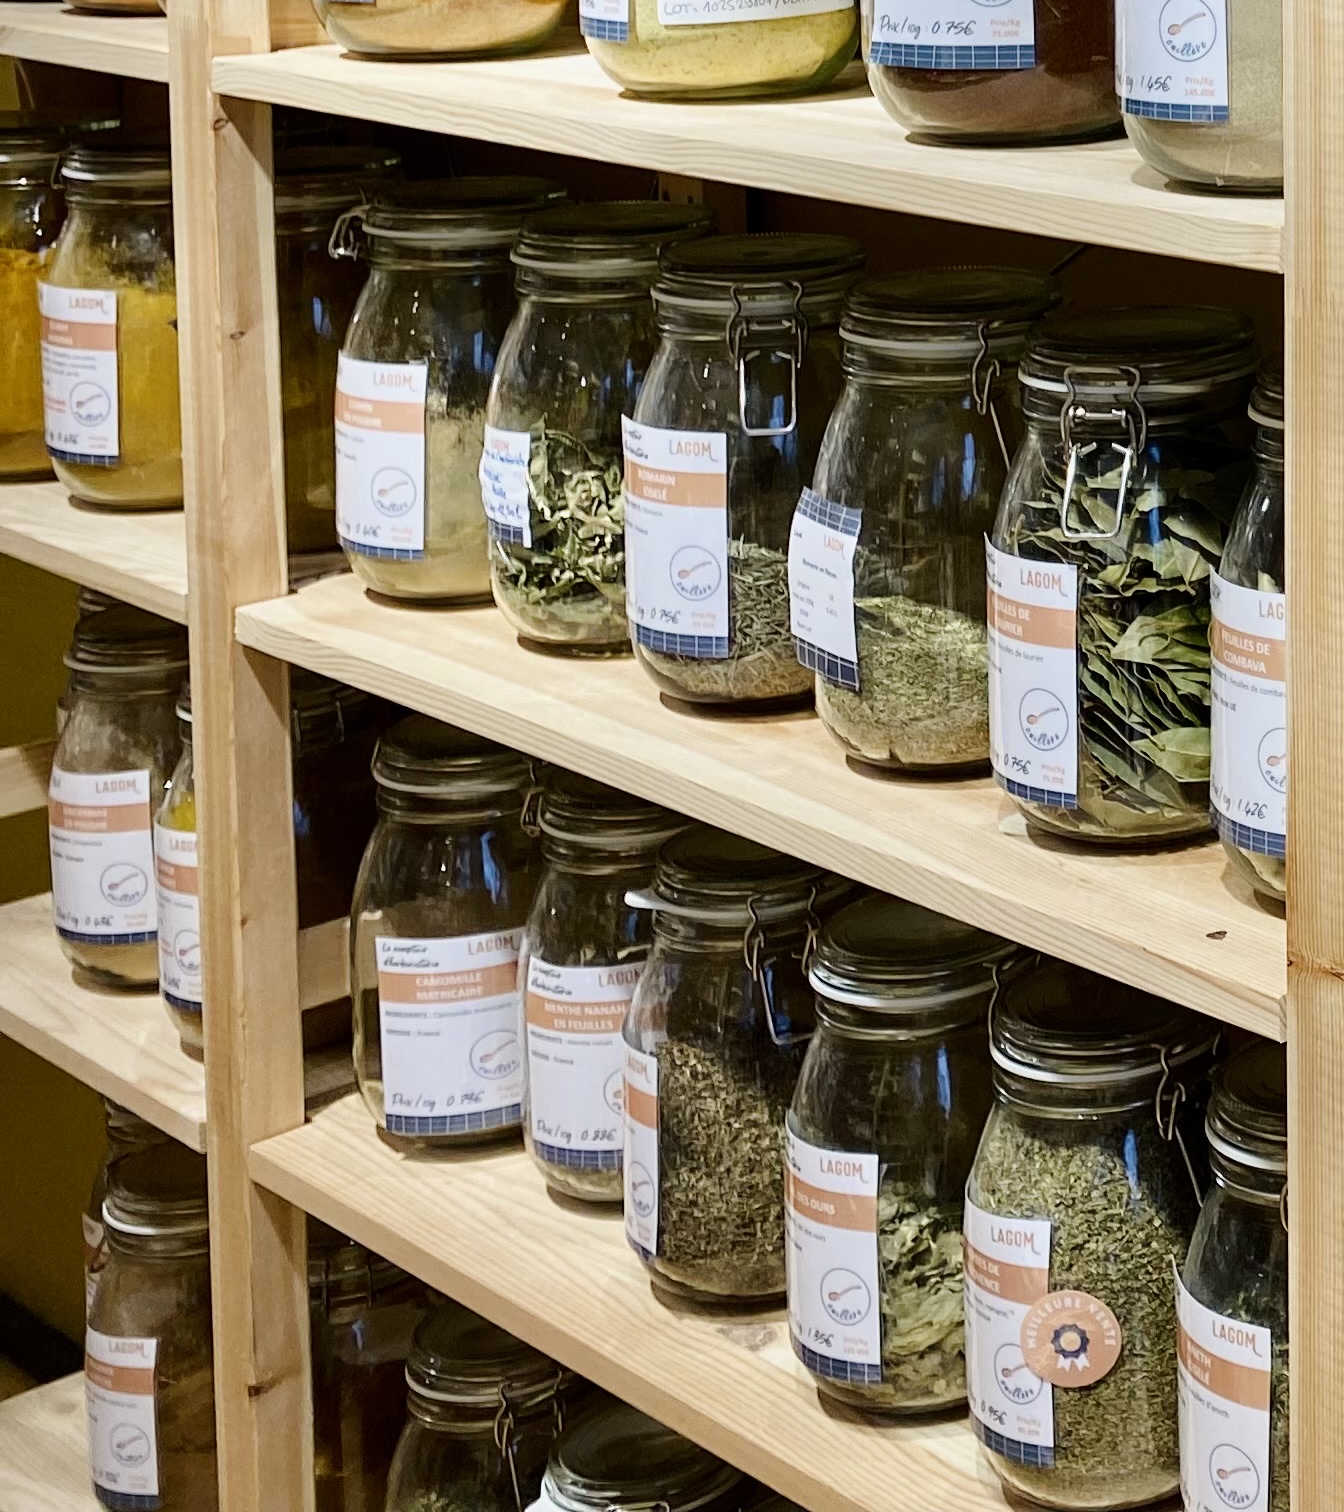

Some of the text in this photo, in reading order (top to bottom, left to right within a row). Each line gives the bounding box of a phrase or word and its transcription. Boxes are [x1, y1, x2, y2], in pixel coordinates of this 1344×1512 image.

[669, 440, 719, 462] LAGOM
[1020, 568, 1068, 597] LAGOM
[1222, 630, 1270, 655] FEUILLES DE
[1224, 651, 1266, 674] COMBAVA
[820, 1157, 869, 1184] LAGOM
[810, 1200, 835, 1215] OURS
[990, 1225, 1041, 1255] LAGOM
[1027, 1296, 1116, 1349] MEILLEURE VENTE
[1212, 1320, 1263, 1357] LAGOM
